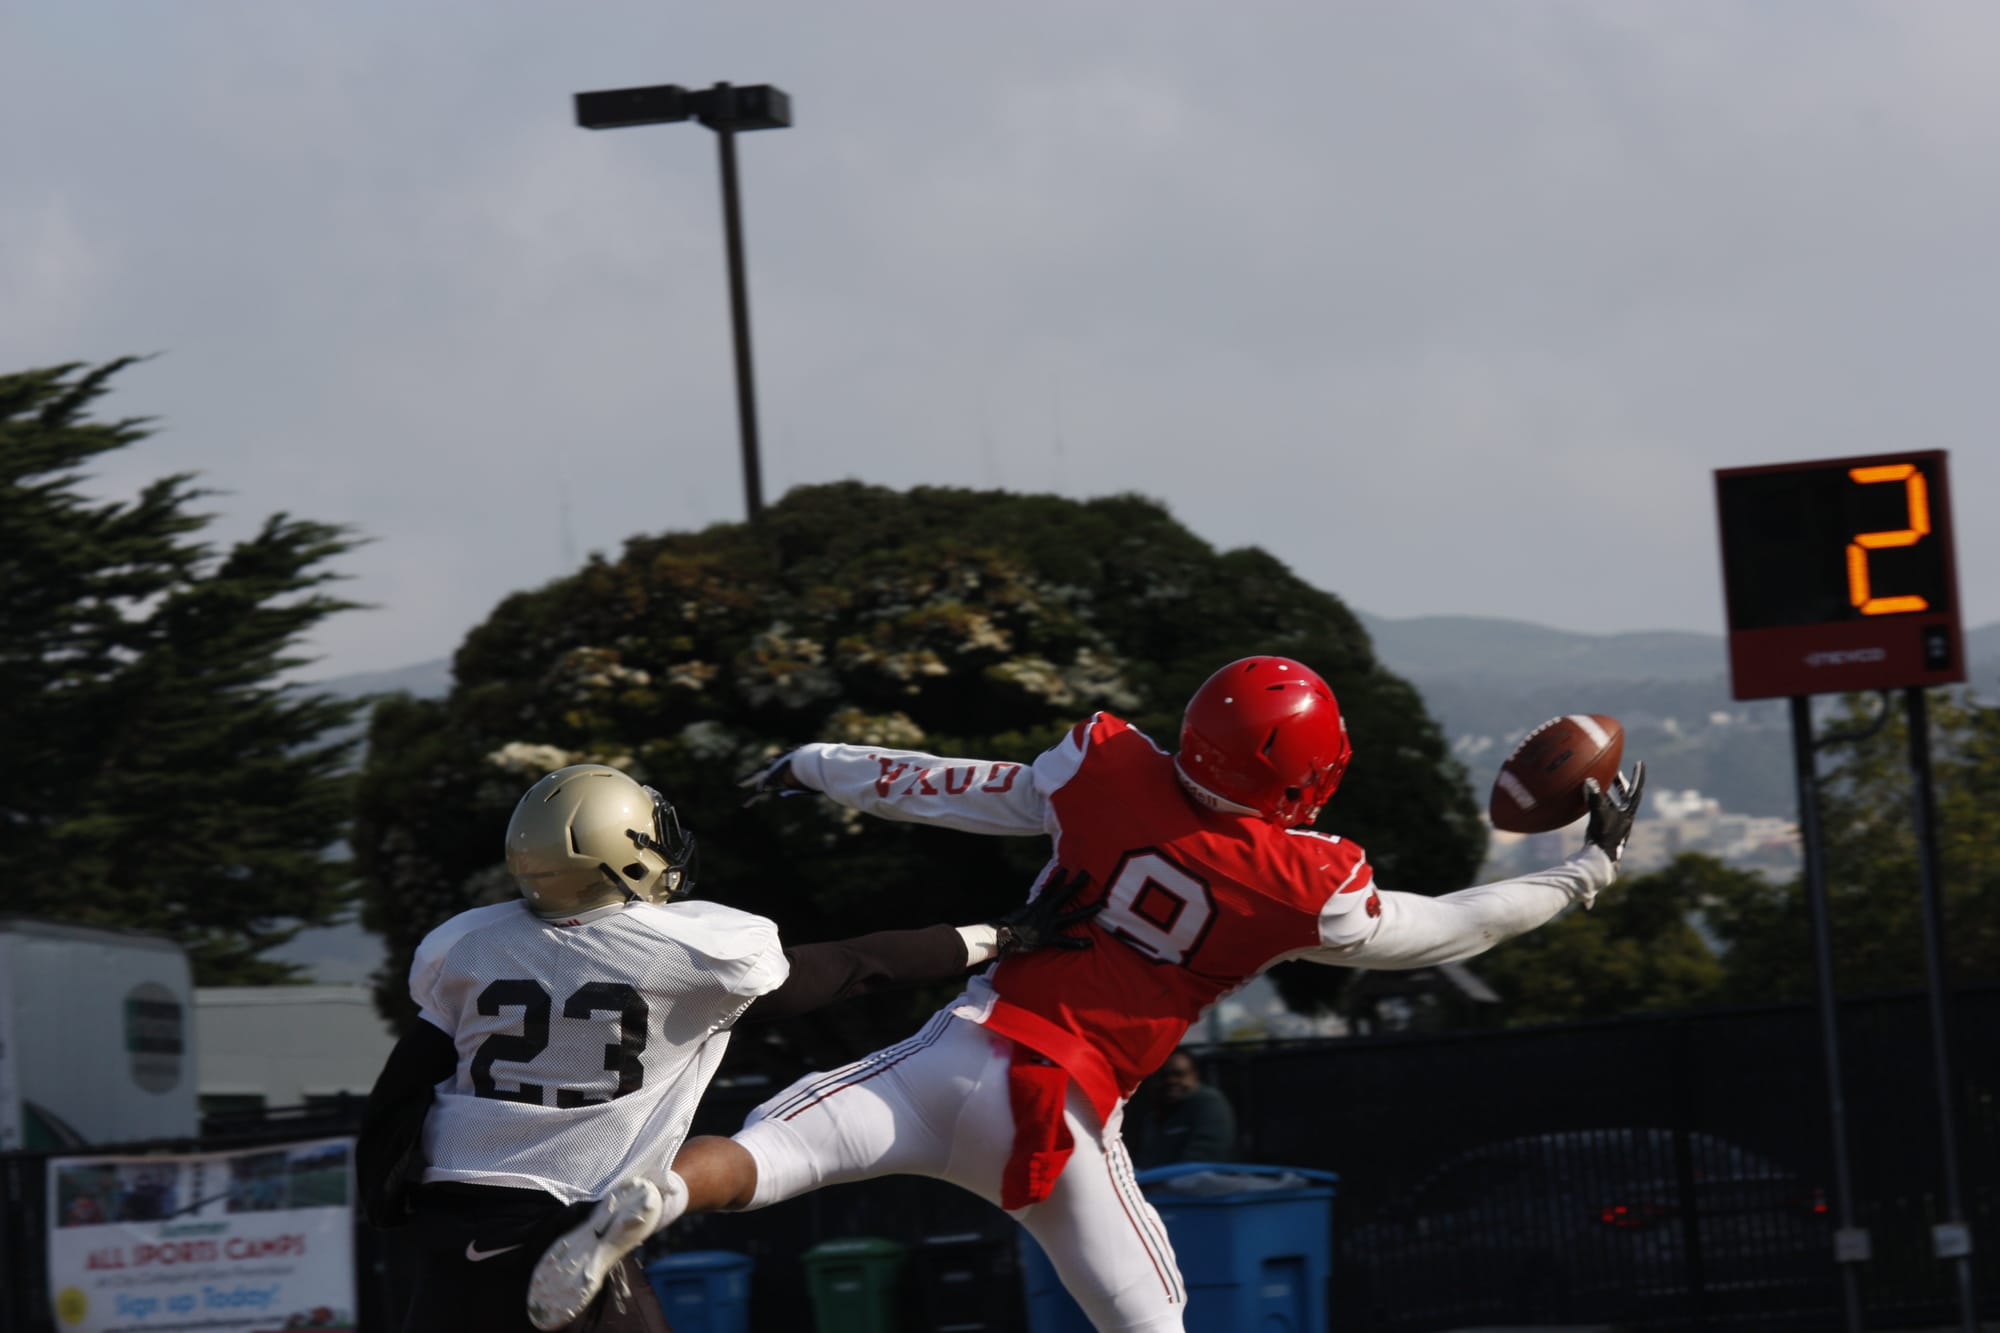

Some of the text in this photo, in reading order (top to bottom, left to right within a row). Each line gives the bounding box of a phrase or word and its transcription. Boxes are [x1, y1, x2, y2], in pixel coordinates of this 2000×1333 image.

[1846, 464, 1931, 615] 2
[470, 979, 649, 1109] 23
[85, 1235, 304, 1271] ALL SPORTS CAMPS
[116, 1294, 158, 1317] Sign
[167, 1293, 195, 1313] up
